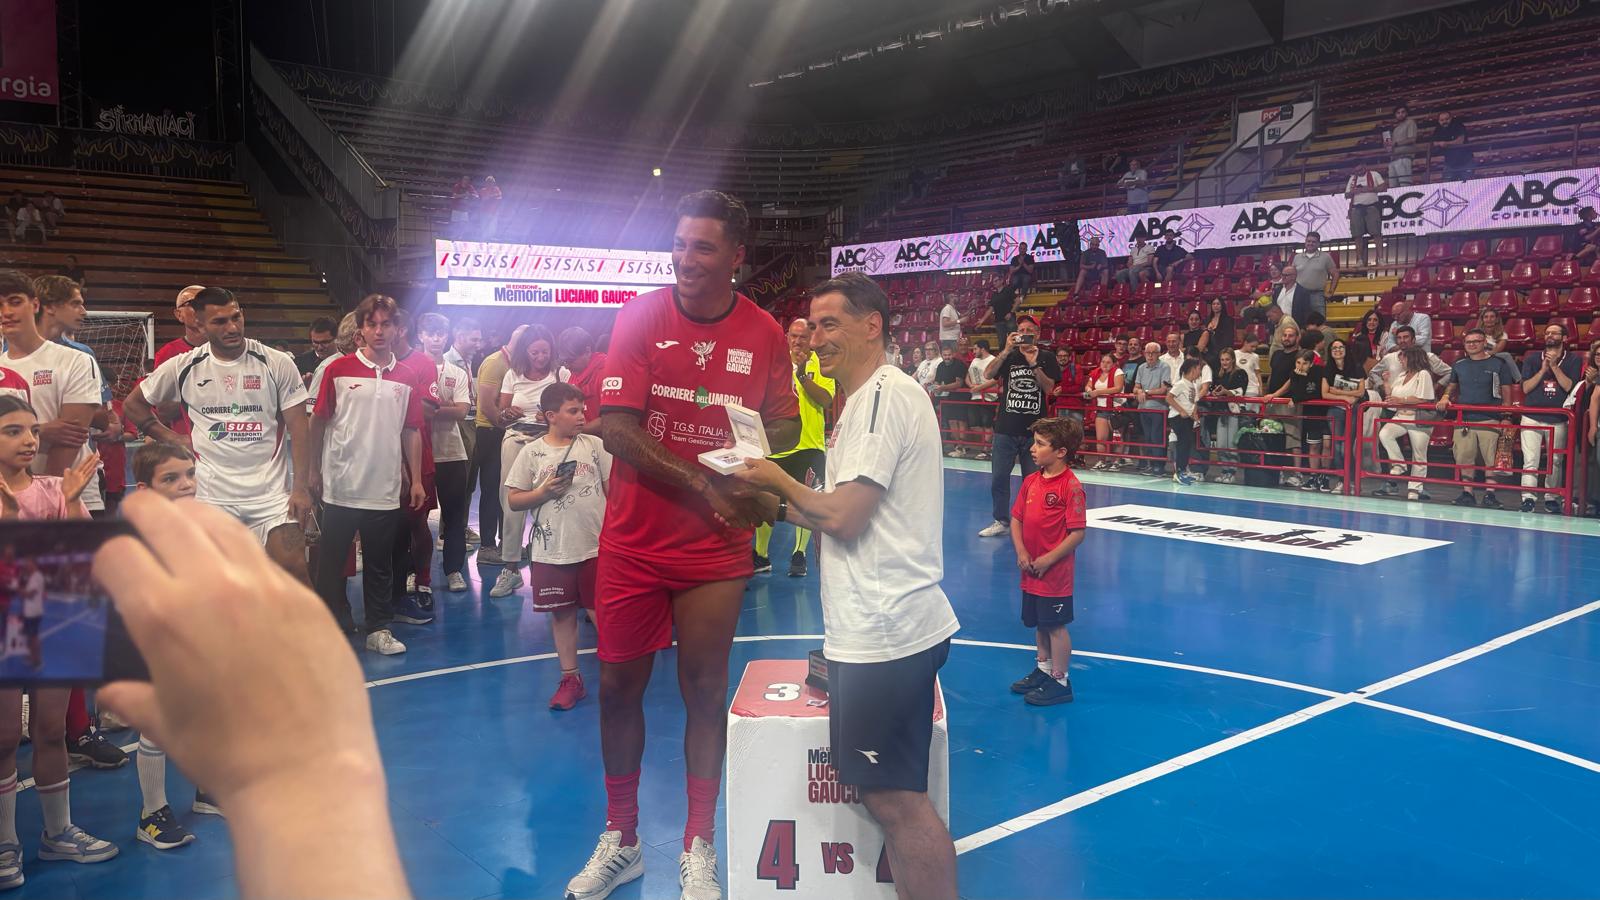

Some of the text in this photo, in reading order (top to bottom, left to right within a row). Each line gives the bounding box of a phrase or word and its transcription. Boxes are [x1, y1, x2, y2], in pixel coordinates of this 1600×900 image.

[1492, 176, 1580, 212] ABC
[1378, 191, 1425, 221] BC
[1492, 207, 1580, 221] COPERTURE
[1128, 215, 1183, 243] ABC
[1231, 204, 1294, 234] ABC
[1383, 219, 1424, 229] RTURE
[962, 233, 1002, 257] ABC
[1031, 227, 1060, 250] AB
[1230, 230, 1294, 241] COPERTURE
[834, 248, 867, 268] ABC
[894, 241, 931, 263] ABC
[894, 260, 931, 269] COPERTURE
[494, 287, 553, 303] Memorial
[555, 288, 599, 304] LUCIANO
[726, 362, 752, 376] GAUCCI
[651, 383, 695, 402] CORRIERE
[708, 392, 743, 407] UMBRIA
[1008, 399, 1039, 410] MOLLO
[201, 404, 263, 415] CORRIERE UMBRIA
[227, 423, 262, 431] SUSA
[698, 425, 724, 438] ITALIA
[671, 434, 687, 442] Team
[688, 437, 714, 447] Gestione
[764, 682, 801, 702] 3
[808, 781, 862, 805] GAUCC
[756, 819, 800, 890] 4
[820, 841, 854, 875] VS
